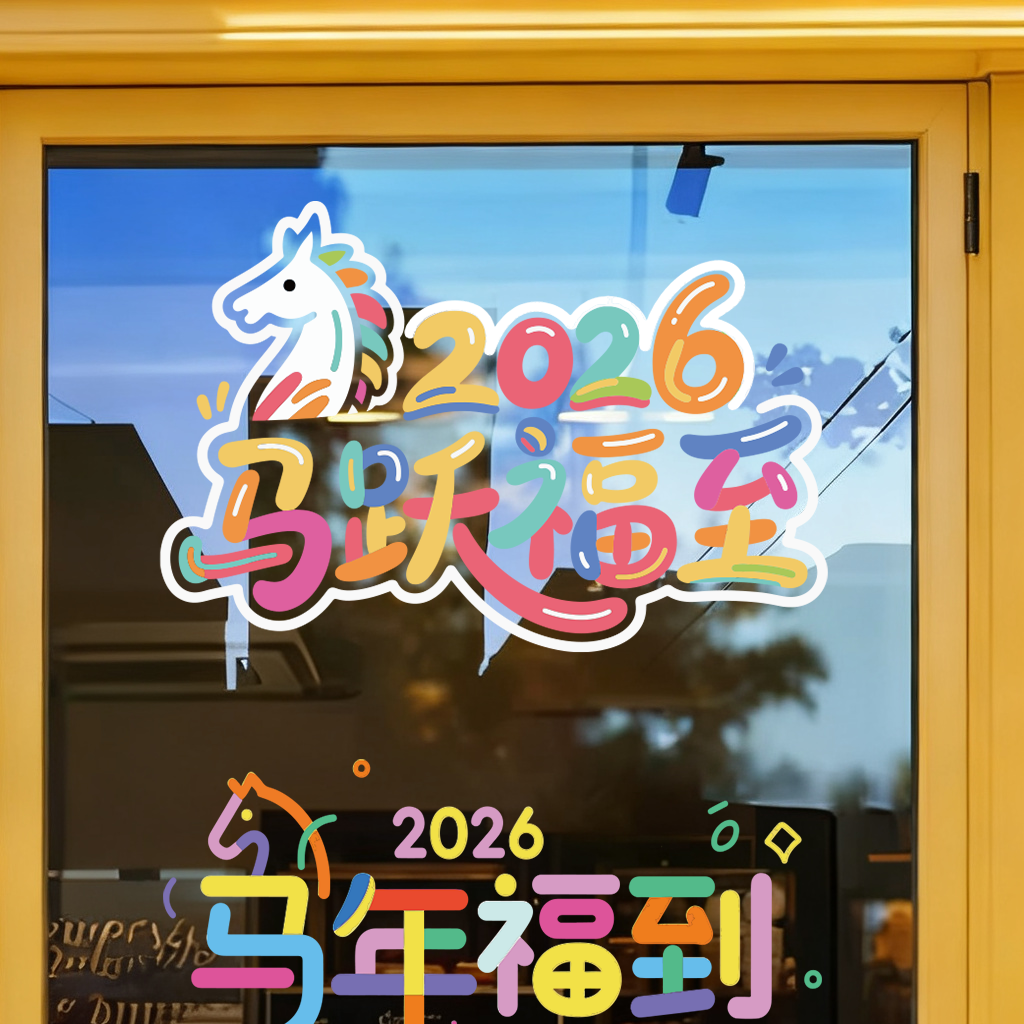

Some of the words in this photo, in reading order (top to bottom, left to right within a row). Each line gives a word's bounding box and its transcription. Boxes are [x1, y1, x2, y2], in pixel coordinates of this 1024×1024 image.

[402, 272, 745, 420] 2026
[178, 414, 808, 634] 马跃福至
[392, 806, 544, 860] 2026
